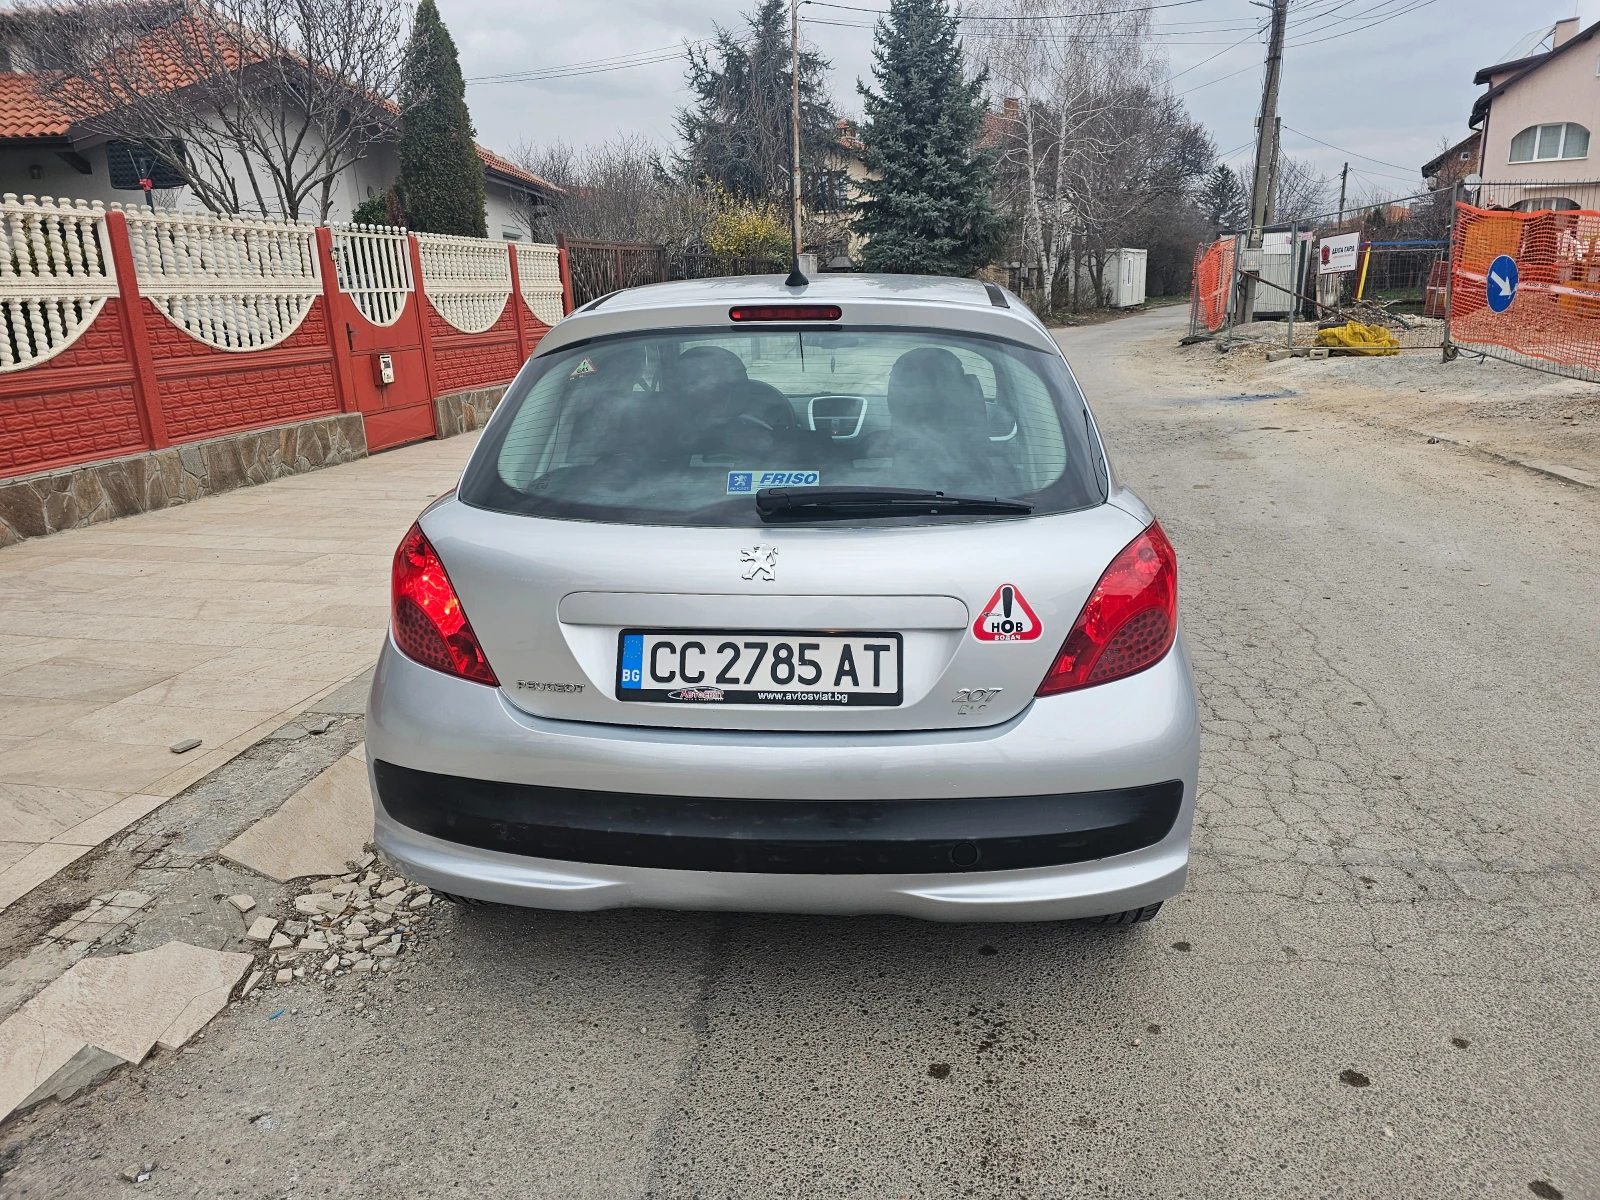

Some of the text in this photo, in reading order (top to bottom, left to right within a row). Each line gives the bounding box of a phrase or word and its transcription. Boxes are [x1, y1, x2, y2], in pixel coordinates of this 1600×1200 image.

[760, 473, 818, 484] FRISO
[992, 620, 1023, 633] НОВ
[715, 642, 823, 686] 2785
[833, 643, 890, 687] AT
[622, 669, 640, 682] BG
[516, 679, 585, 693] PEUGEOT
[757, 691, 848, 703] www.avtosviat.bg
[952, 687, 1004, 703] 207
